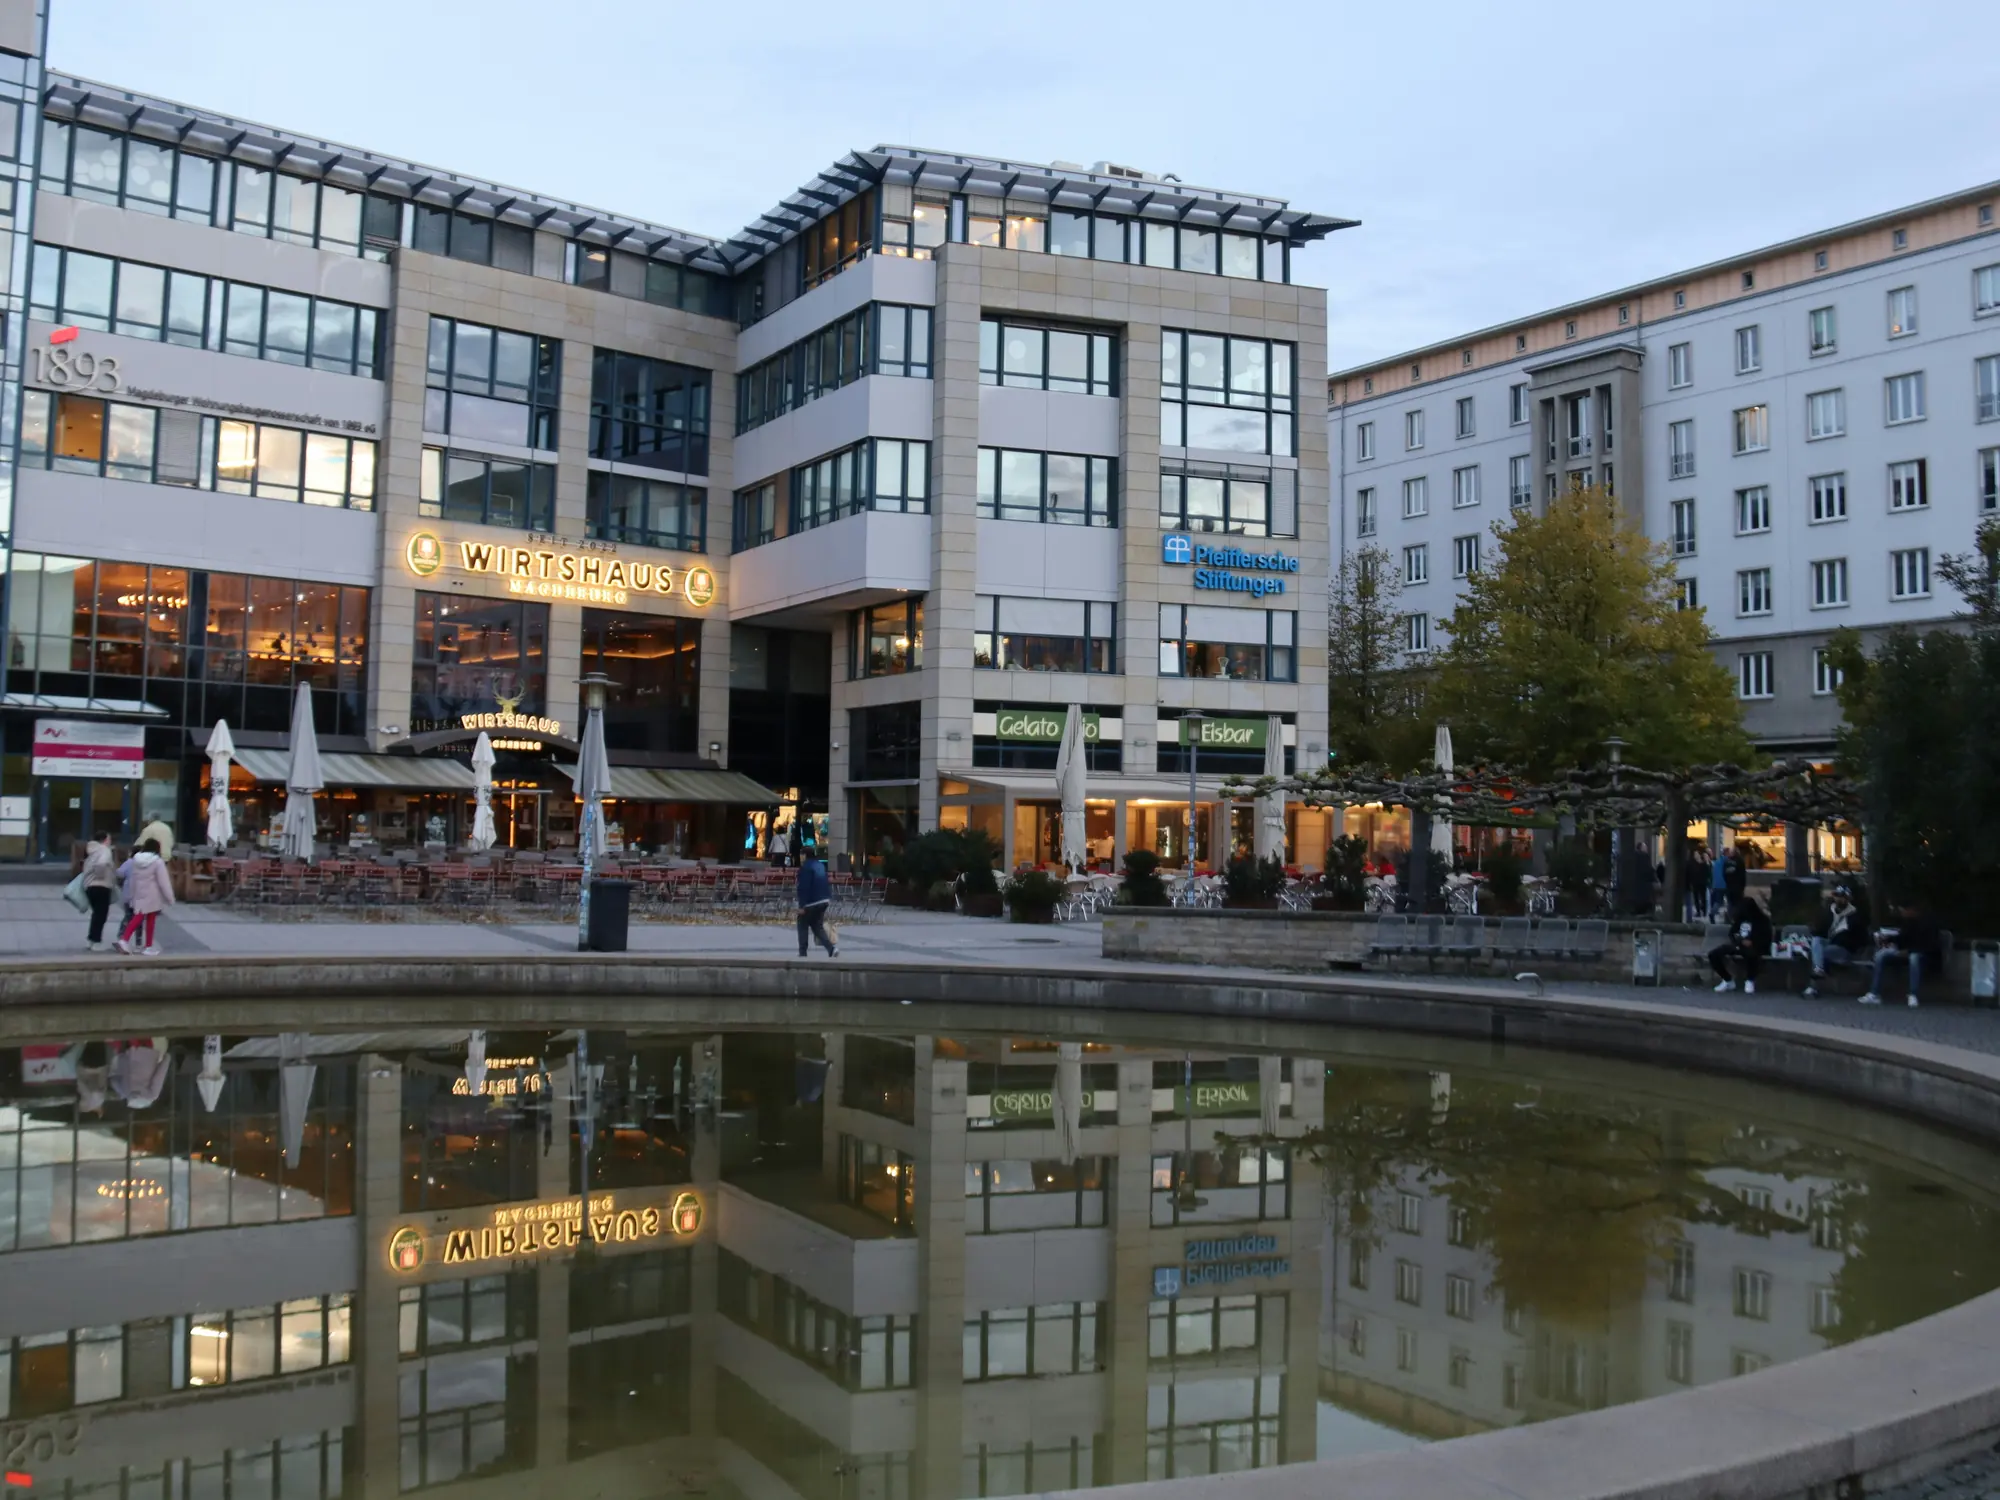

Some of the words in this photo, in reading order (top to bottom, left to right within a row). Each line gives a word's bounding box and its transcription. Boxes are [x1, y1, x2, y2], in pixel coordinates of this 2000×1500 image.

[33, 345, 121, 393] 1893
[527, 533, 568, 547] SEIT
[577, 540, 617, 553] 2022
[460, 541, 672, 594] WIRTSHAUS
[1194, 544, 1299, 572] Pfeiffersche
[509, 578, 628, 605] MAGDEBURG
[1194, 567, 1285, 598] Stiftungen
[461, 712, 560, 735] WIRTSHAUS
[999, 715, 1059, 738] Gelato
[1201, 721, 1254, 744] Eisbar
